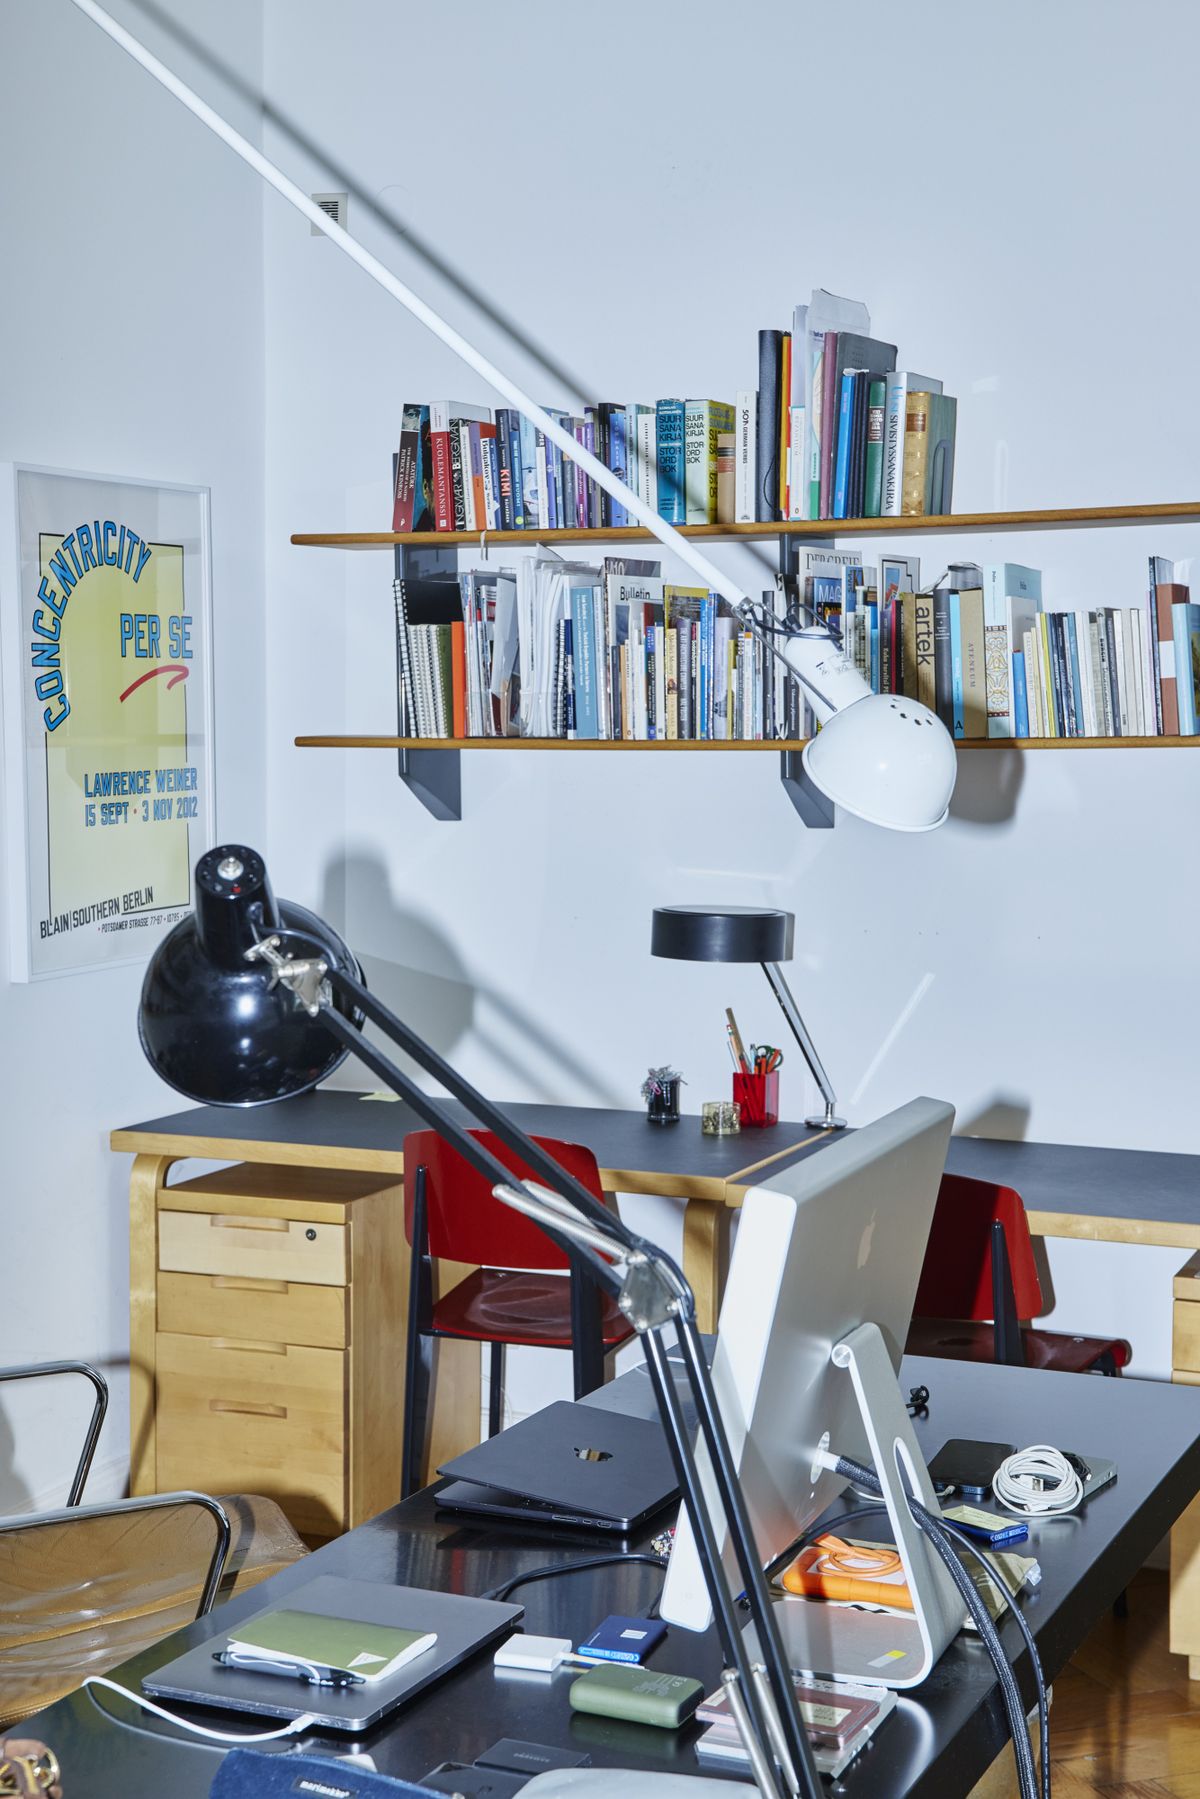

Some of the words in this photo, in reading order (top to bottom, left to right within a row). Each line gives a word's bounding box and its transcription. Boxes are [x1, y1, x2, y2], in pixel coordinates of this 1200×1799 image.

[659, 414, 682, 423] SUUR
[686, 414, 704, 422] SUUR
[448, 418, 462, 470] BERGMAN
[659, 447, 682, 455] STOR
[481, 440, 490, 480] Bulgakov
[886, 414, 898, 510] SIVISTYSSANAKIRJA
[436, 438, 446, 518] KUOLEMANTANSSI
[500, 469, 511, 496] KIMI
[620, 586, 650, 601] Bulletin
[31, 520, 152, 732] CONCENTRICITY
[120, 613, 160, 658] PER
[168, 615, 193, 658] SE
[916, 606, 936, 666] artek
[84, 770, 151, 798] LAWRENCE
[155, 767, 198, 793] WEINER
[85, 804, 96, 827] 15
[100, 802, 129, 826] SEPT
[142, 800, 149, 822] 3
[153, 798, 173, 821] NOV
[177, 796, 198, 819] 2012
[122, 886, 154, 912] BERLIN
[129, 917, 149, 929] STRASSE
